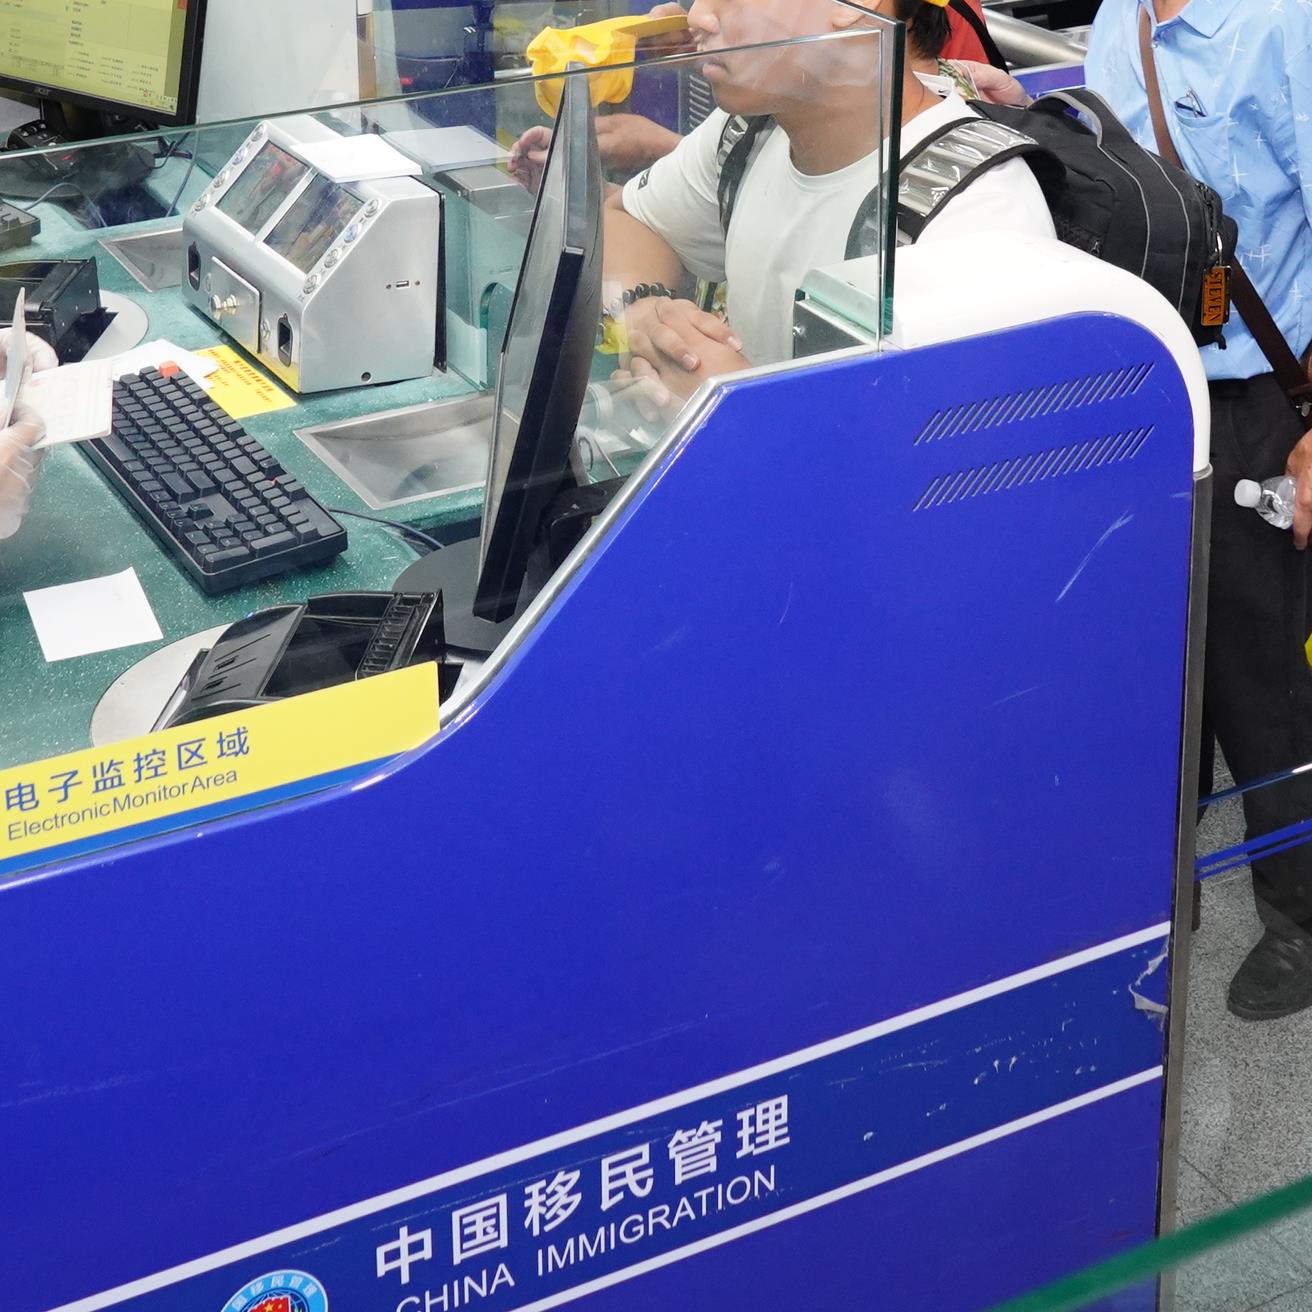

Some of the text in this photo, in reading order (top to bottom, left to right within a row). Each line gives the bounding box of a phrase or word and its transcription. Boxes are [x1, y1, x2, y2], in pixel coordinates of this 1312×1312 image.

[1207, 271, 1223, 322] STEVEN
[4, 726, 251, 813] 电子监控区域
[7, 768, 238, 842] Electronic Monitor Area
[375, 1093, 792, 1286] 中国移民管理
[395, 1165, 778, 1312] CHINA IMMIGRATION
